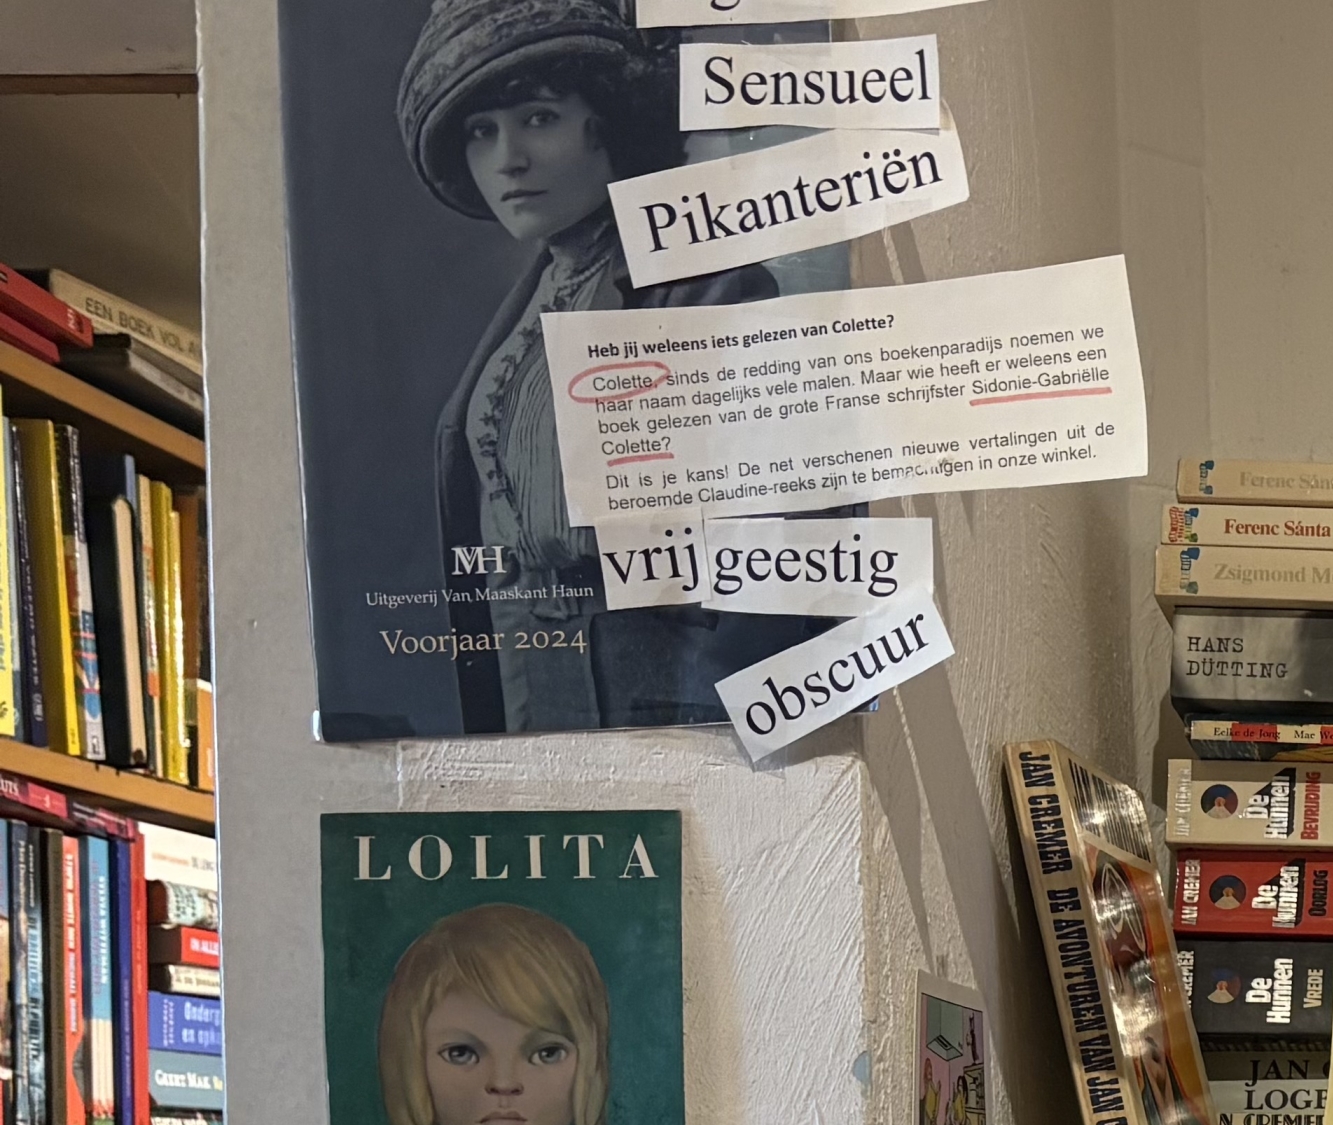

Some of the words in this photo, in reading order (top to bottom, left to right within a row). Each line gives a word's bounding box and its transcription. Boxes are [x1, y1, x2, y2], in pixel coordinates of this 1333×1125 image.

[703, 52, 932, 106] Sensueel
[640, 148, 944, 254] Pikanteriën
[588, 343, 620, 358] Heb
[624, 341, 638, 358] jij
[642, 338, 707, 354] weleens
[711, 334, 739, 349] iets
[742, 328, 797, 348] gelezen
[801, 323, 828, 337] van
[832, 315, 894, 333] Colette?
[666, 369, 710, 385] sinds
[717, 367, 736, 381] de
[744, 359, 801, 378] redding
[808, 355, 836, 369] van
[844, 352, 873, 365] ons
[880, 337, 1003, 362] boekenparadijs
[1010, 329, 1074, 348] noemen
[1081, 326, 1104, 340] we
[1224, 519, 1279, 536] Ferenc
[1284, 520, 1331, 538] Sánta
[714, 535, 898, 596] geestig
[1214, 562, 1306, 586] Zsigmond
[367, 590, 438, 609] Uitgeverij
[442, 589, 471, 602] Van
[475, 586, 547, 601] Maaskant
[551, 584, 593, 598] Haun
[380, 627, 506, 659] Voorjaar
[515, 630, 587, 653] 2024
[1186, 636, 1244, 654] HANS
[745, 610, 929, 736] obscuur
[1186, 658, 1288, 678] DÜTTING
[353, 835, 658, 881] LOLITA
